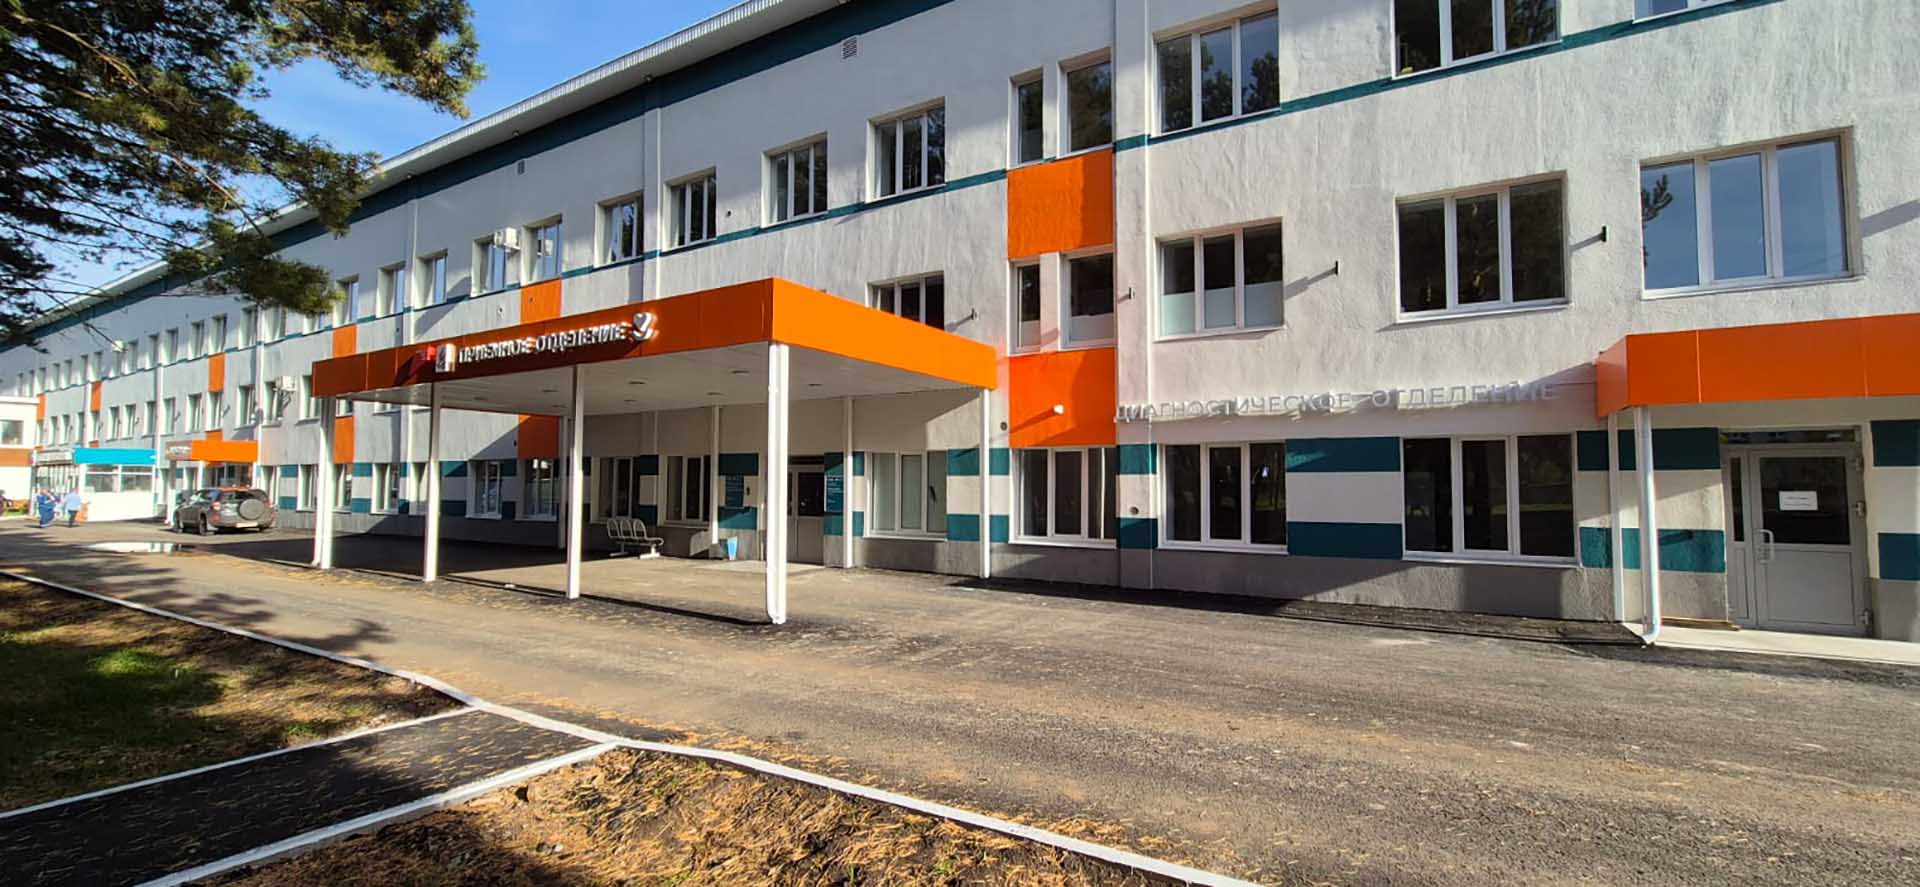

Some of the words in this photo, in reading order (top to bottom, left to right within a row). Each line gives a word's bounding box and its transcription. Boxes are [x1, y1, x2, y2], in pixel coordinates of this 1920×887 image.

[459, 338, 535, 363] ПРИЕМНОЕ
[536, 322, 628, 352] ОТДЕЛЕНИЕ
[1115, 394, 1353, 422] ДИАГНОСТИЧЕСКОЕ
[1372, 384, 1557, 407] ОТДЕЛЕНИЕ
